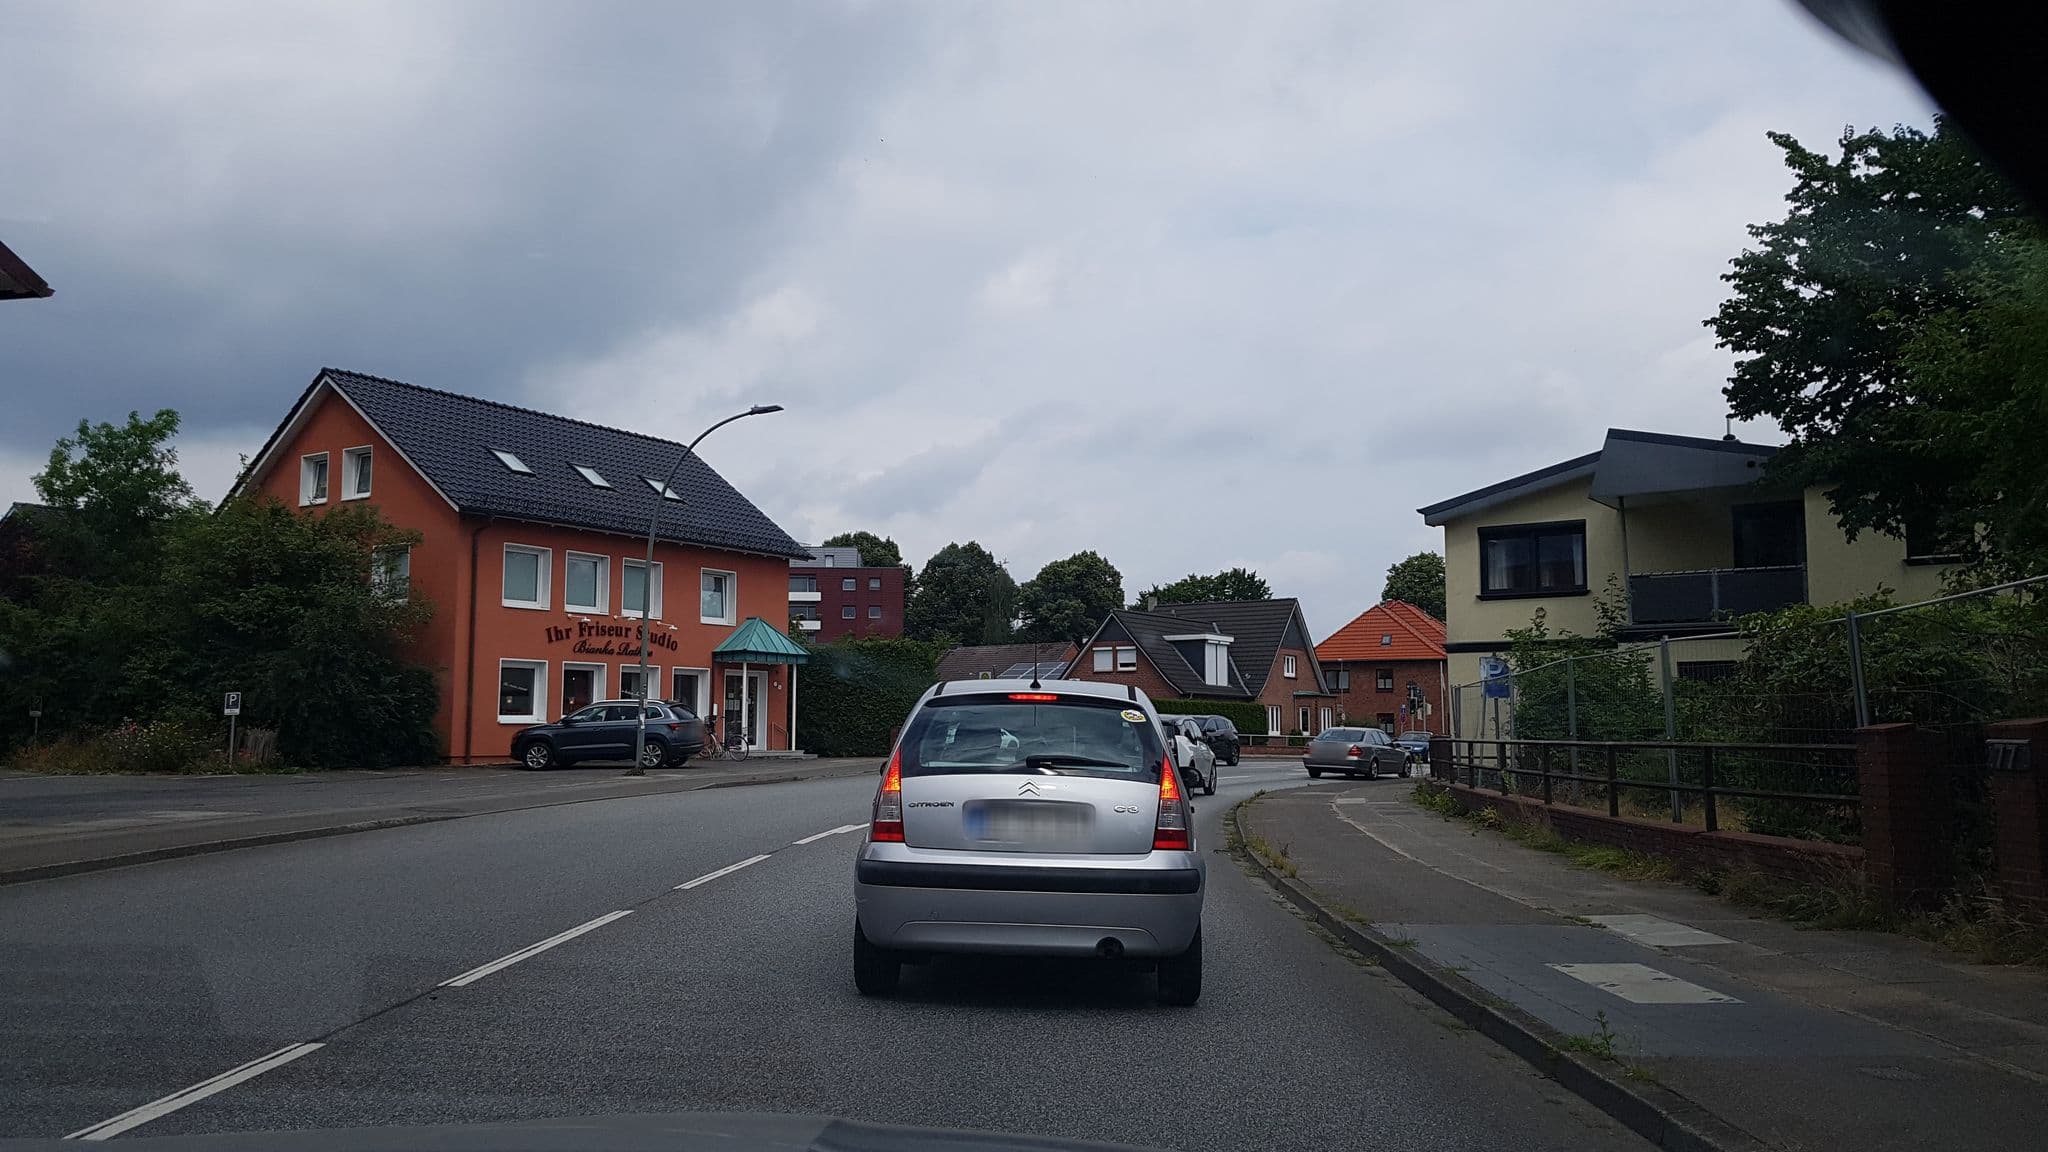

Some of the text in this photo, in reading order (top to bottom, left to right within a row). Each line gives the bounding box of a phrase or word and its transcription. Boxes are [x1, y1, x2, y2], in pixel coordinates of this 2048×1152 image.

[545, 621, 678, 651] Ihr Friseur Sudio
[229, 694, 237, 706] P
[1113, 805, 1140, 814] C3
